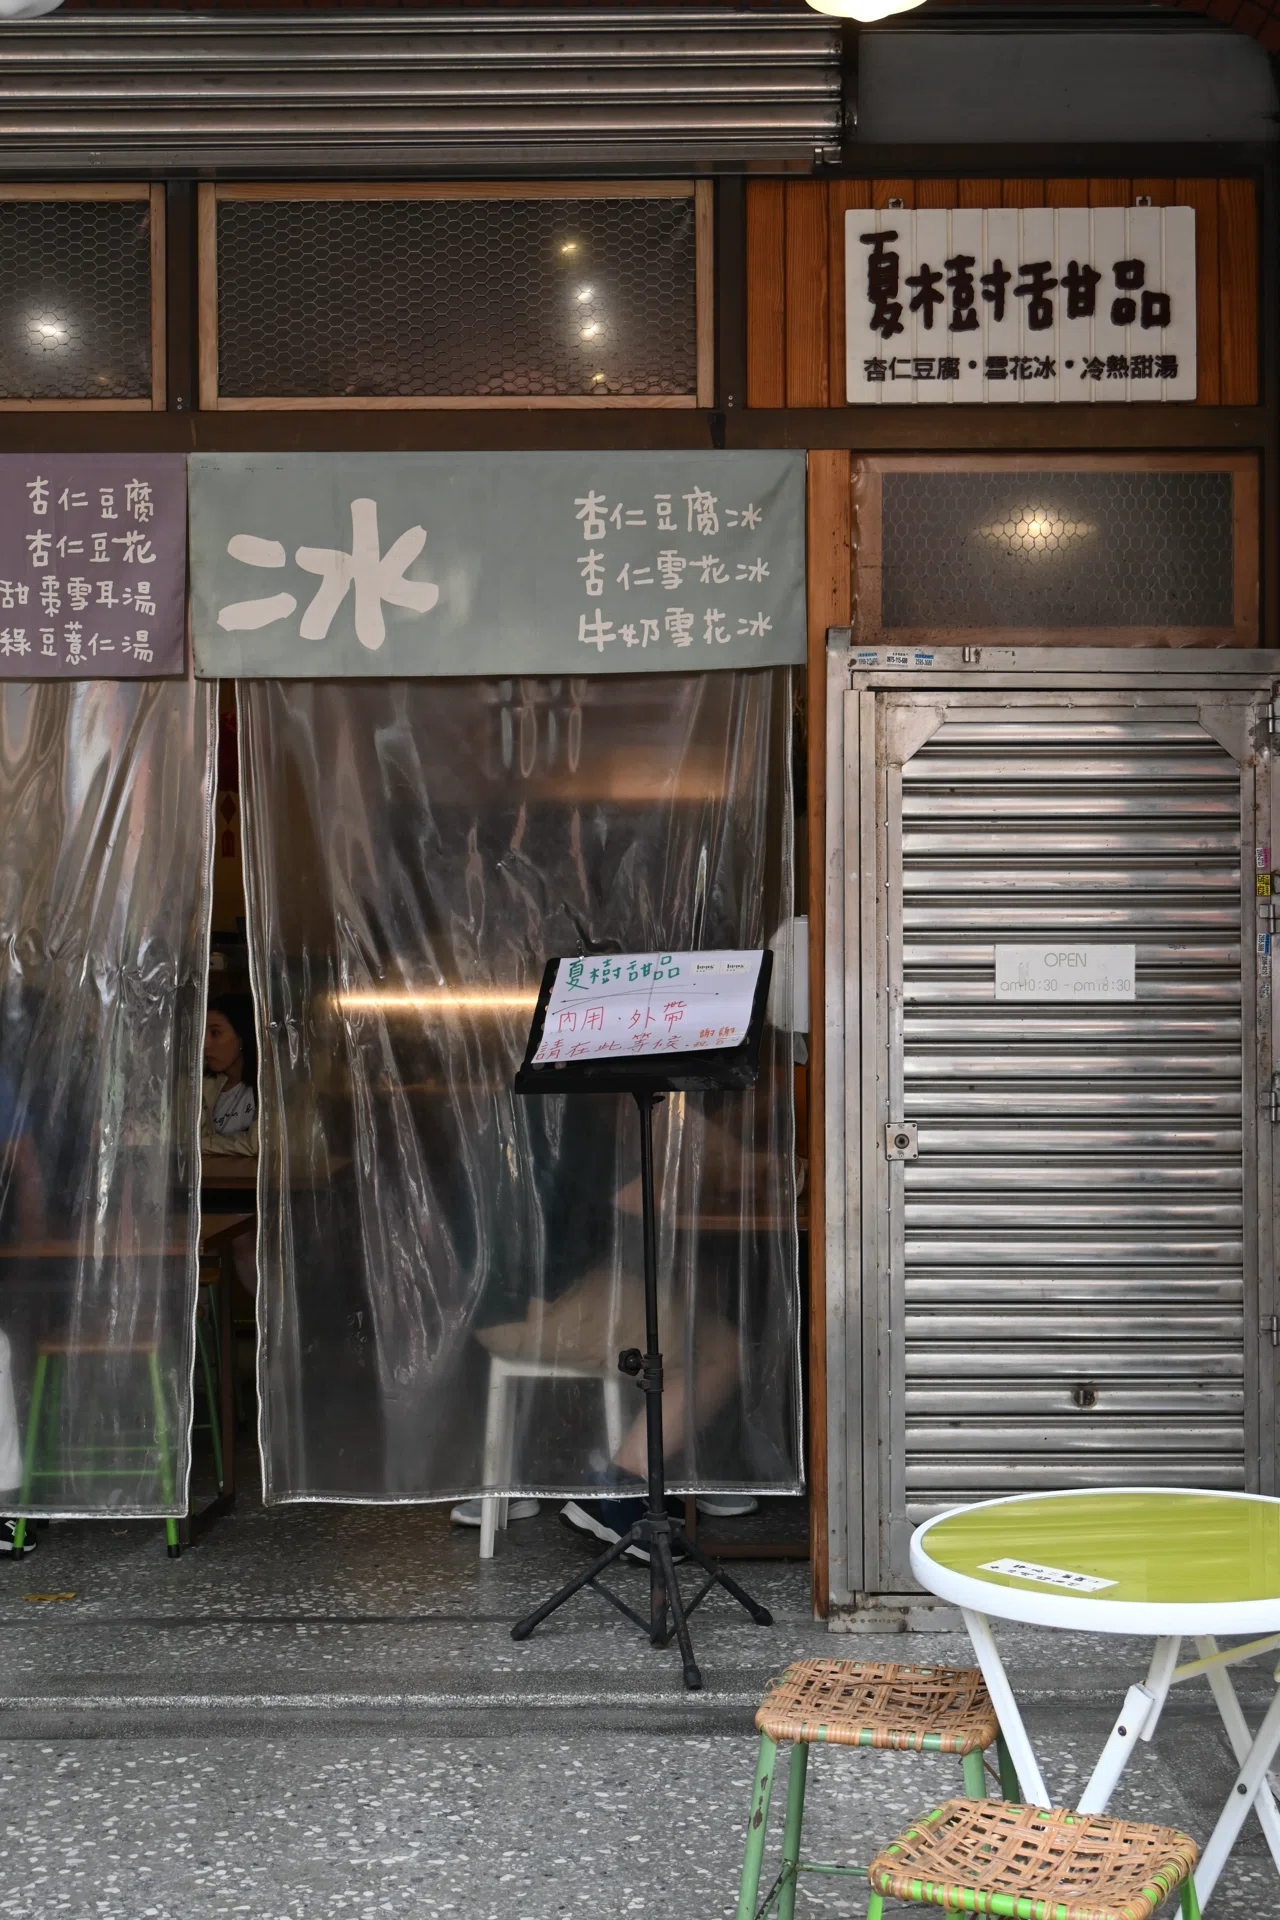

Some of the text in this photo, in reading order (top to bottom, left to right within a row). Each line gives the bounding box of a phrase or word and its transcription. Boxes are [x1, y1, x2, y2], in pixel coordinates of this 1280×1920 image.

[859, 230, 1171, 339] 夏樹甜品
[26, 475, 155, 523] 杏仁豆腐
[574, 486, 763, 541] 杏仁豆腐冰
[25, 529, 157, 567] 杏仁豆花
[216, 497, 440, 651] 冰
[576, 548, 771, 596] 杏仁雪花冰
[0, 621, 154, 665] 綠豆薏仁湯
[577, 607, 773, 652] 牛奶雪花冰
[565, 955, 681, 992] 夏樹甜品
[1044, 952, 1088, 968] OPEN
